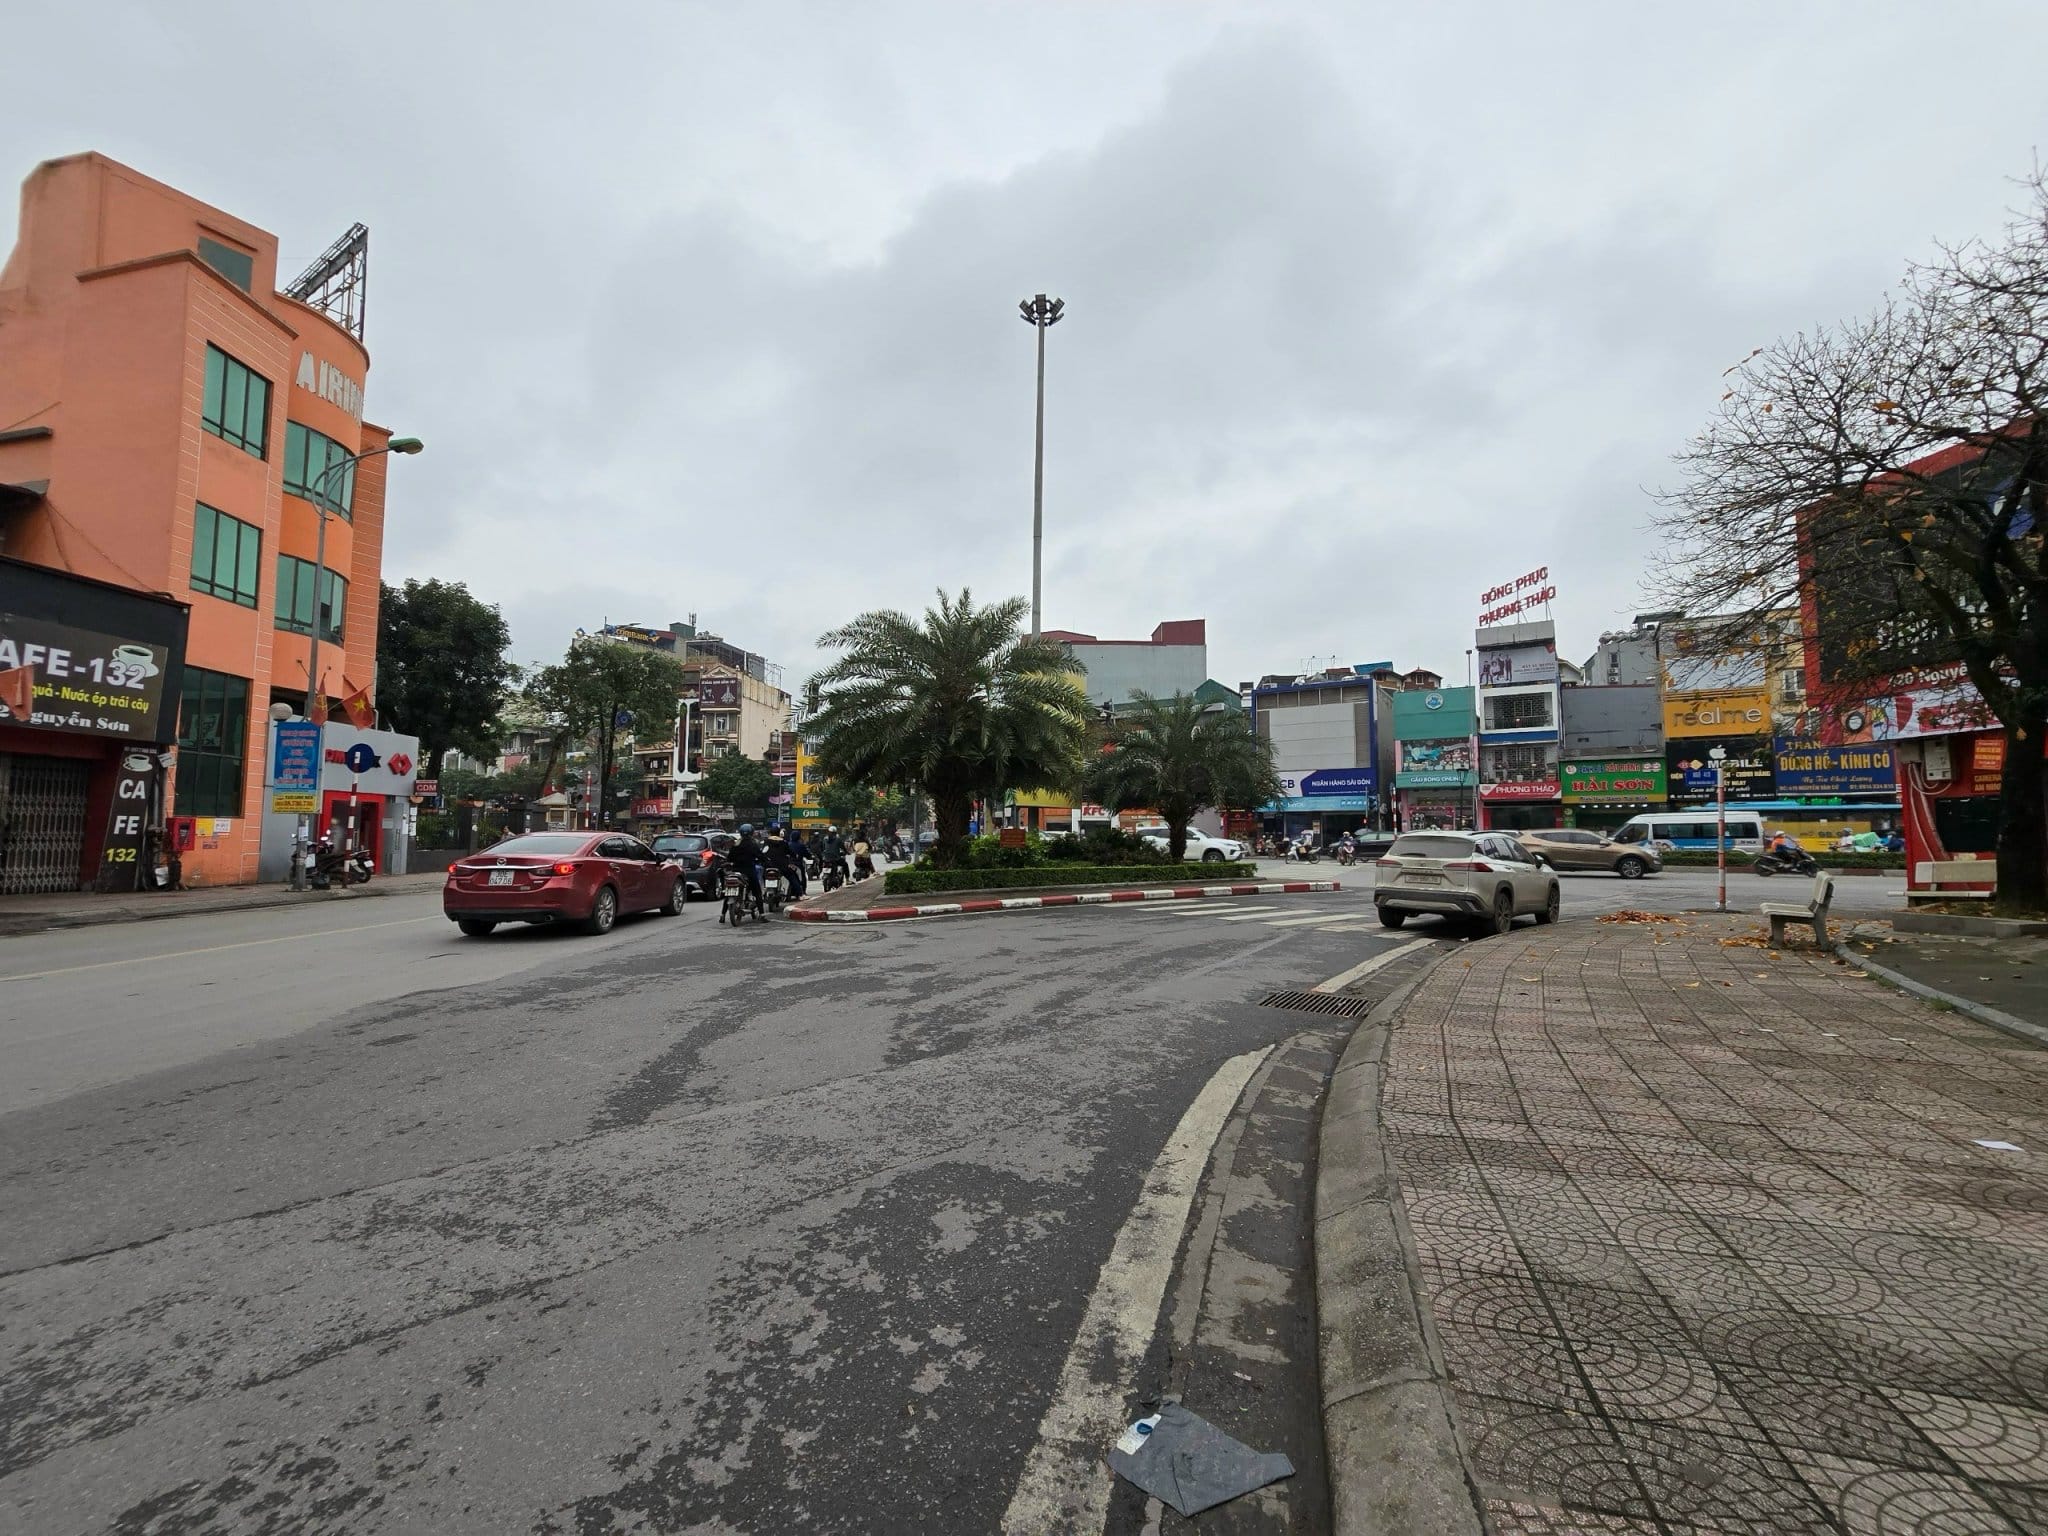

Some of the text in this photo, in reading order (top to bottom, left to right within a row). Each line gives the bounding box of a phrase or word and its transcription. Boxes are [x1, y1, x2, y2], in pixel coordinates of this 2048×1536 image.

[1481, 567, 1548, 605] ĐỒNG PHỤC
[1479, 586, 1556, 626] PHƯƠNG THẢO
[0, 639, 146, 690] AFE-132
[61, 686, 89, 702] Nước
[92, 692, 107, 706] ép
[110, 694, 128, 708] trái
[132, 697, 149, 714] cây
[30, 711, 91, 728] guyễn
[97, 717, 130, 732] Sơn
[1674, 707, 1761, 726] realme
[1840, 752, 1871, 770] KÍNH
[119, 779, 146, 799] CA
[1280, 779, 1295, 788] CB
[1495, 784, 1555, 794] PHƯƠNG THẢO
[1572, 775, 1654, 791] HẢI SƠN
[1082, 805, 1105, 816] KFC
[113, 815, 140, 835] FE
[106, 848, 137, 862] 132
